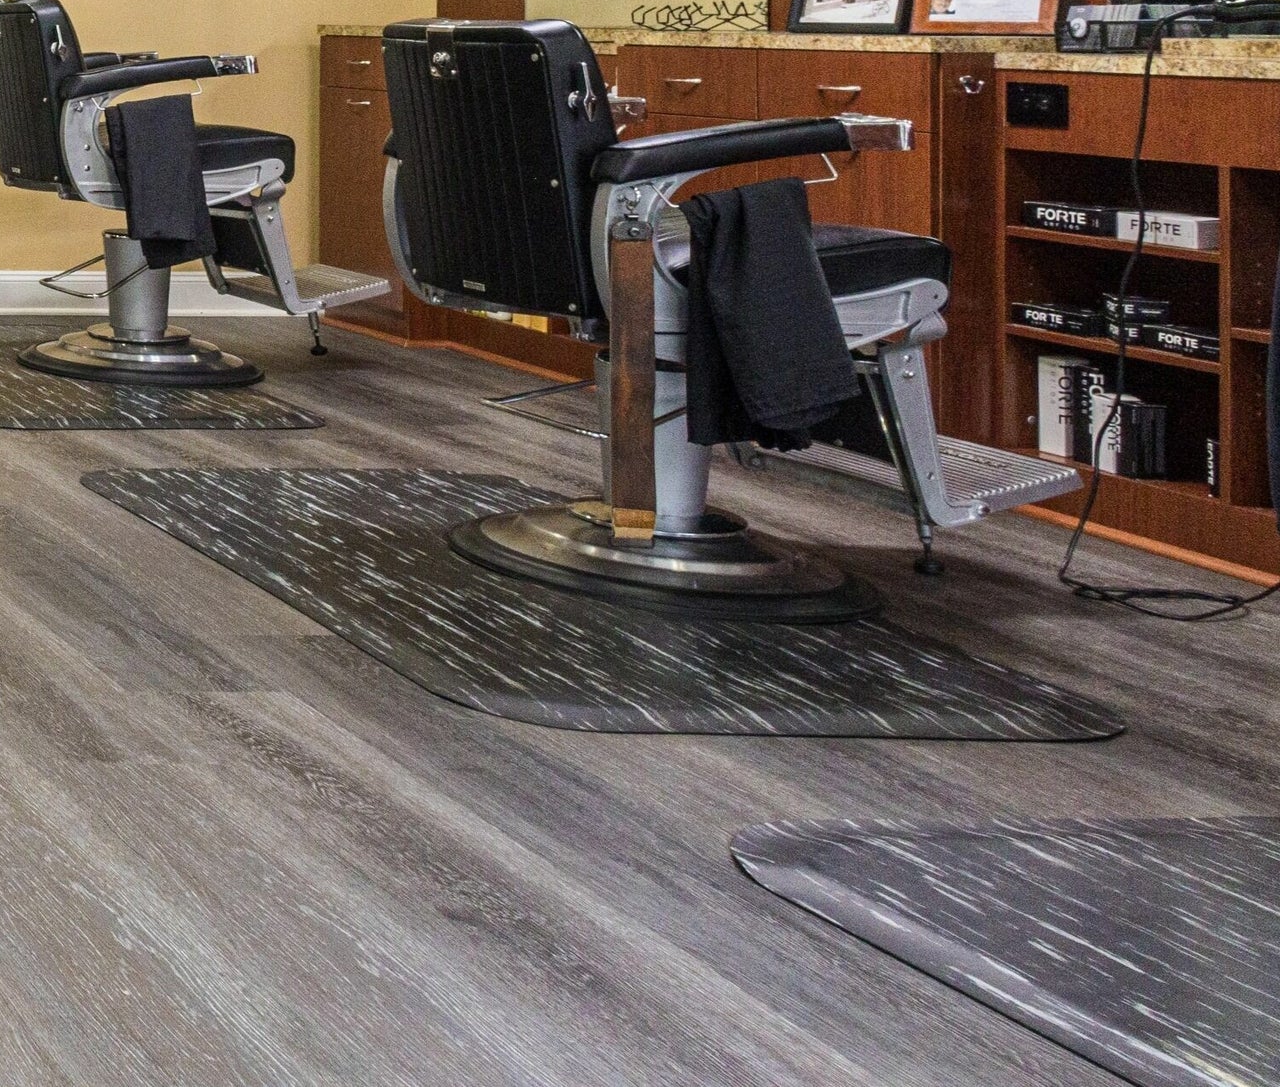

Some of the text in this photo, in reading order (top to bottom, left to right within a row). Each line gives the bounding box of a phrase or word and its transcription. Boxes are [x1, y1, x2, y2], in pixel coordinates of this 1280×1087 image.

[1037, 207, 1087, 224] FORTE
[1130, 219, 1181, 236] FORTE
[1025, 310, 1063, 324] FORTE
[1158, 332, 1199, 349] FORTE
